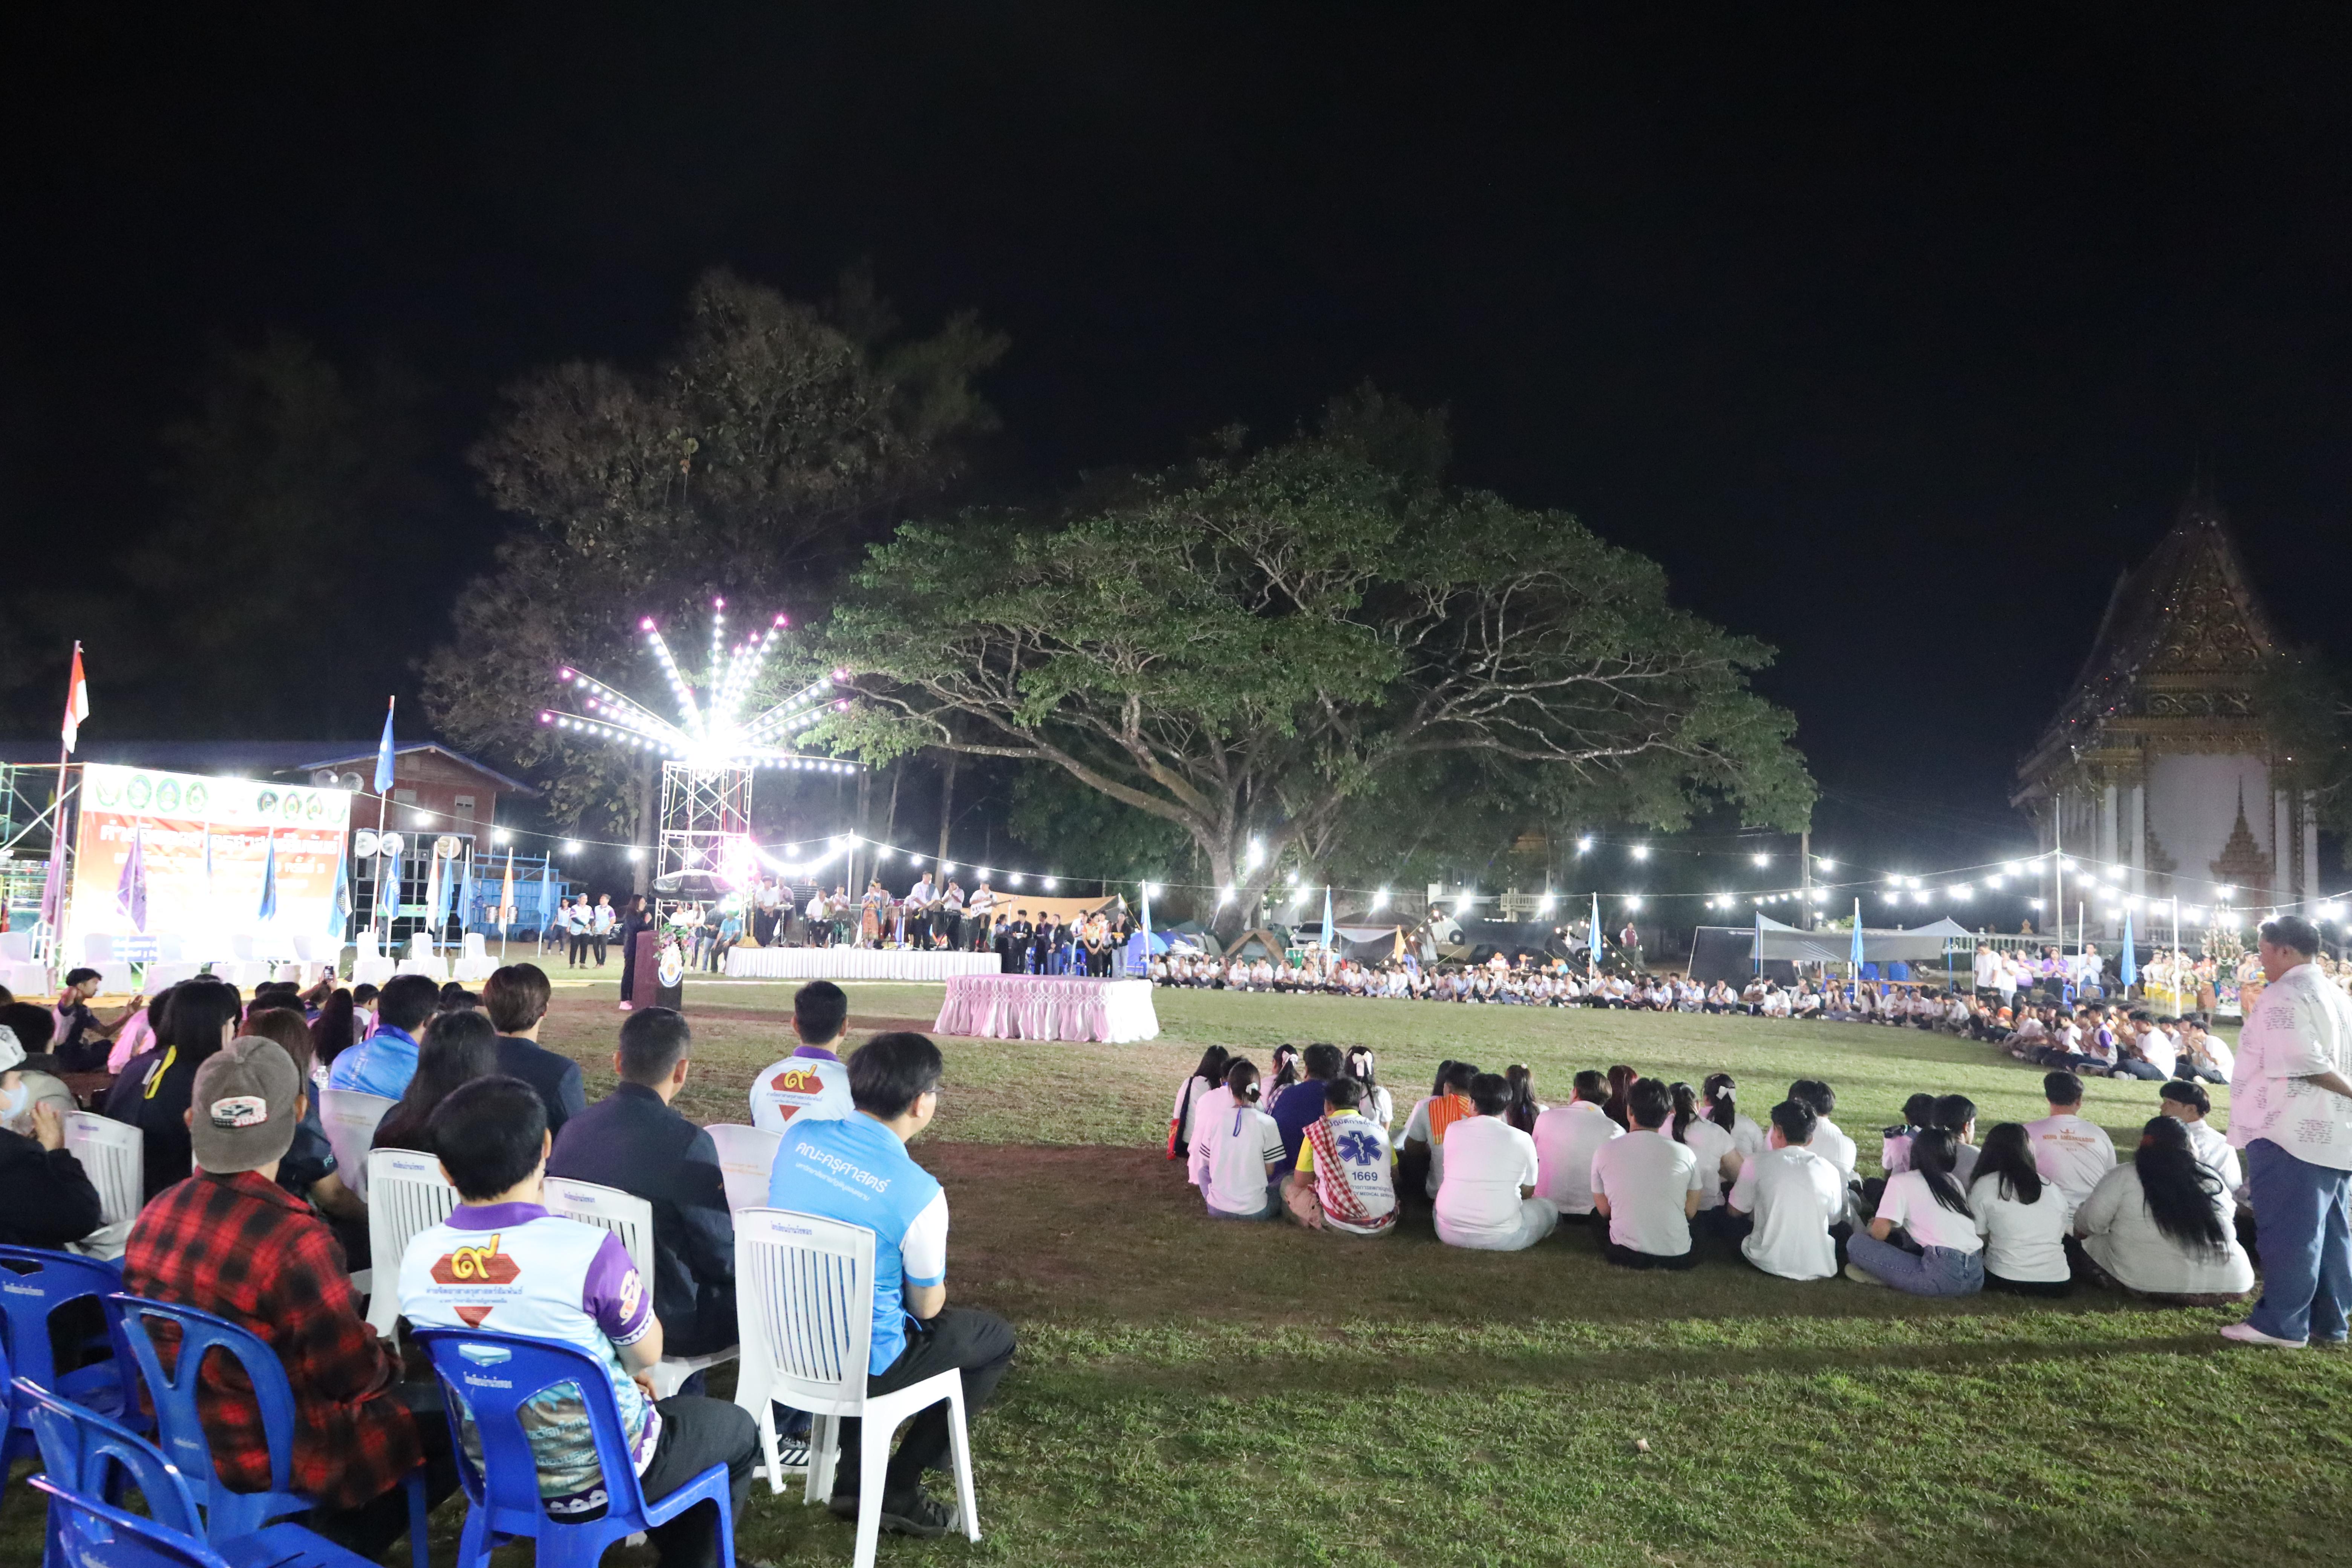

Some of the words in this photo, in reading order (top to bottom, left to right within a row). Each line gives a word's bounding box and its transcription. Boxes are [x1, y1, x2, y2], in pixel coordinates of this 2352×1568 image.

[795, 1142, 892, 1193] คณะครุศาสตร์
[1352, 1171, 1378, 1181] 1669
